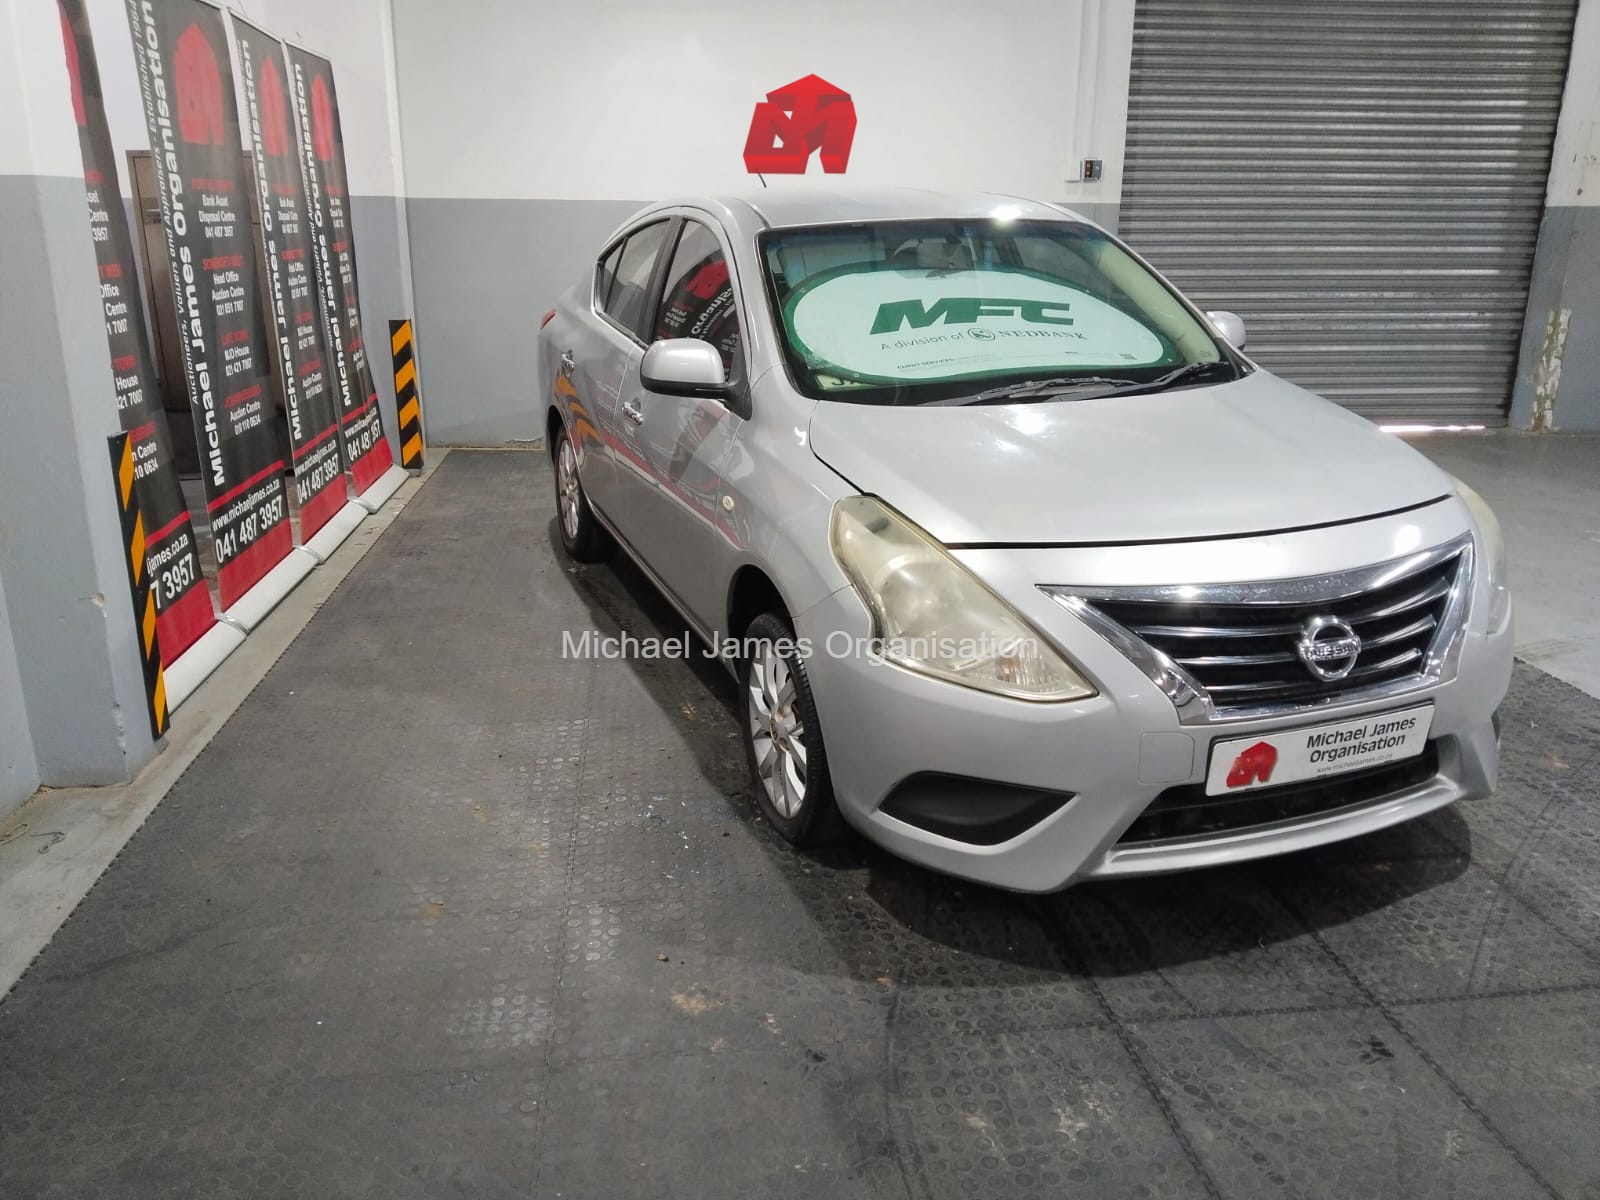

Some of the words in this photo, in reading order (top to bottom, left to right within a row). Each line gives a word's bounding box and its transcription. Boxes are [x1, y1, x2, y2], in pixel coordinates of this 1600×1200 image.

[136, 42, 157, 133] Established
[142, 0, 187, 236] Organisation
[242, 40, 272, 232] Organisation
[295, 63, 322, 228] Organisation
[154, 147, 172, 226] Appraisers
[165, 228, 177, 257] and
[171, 262, 185, 314] Valuers
[180, 246, 205, 353] James
[225, 270, 239, 283] Office
[229, 286, 245, 298] Centre
[268, 240, 286, 329] James
[319, 234, 336, 311] James
[869, 297, 1074, 335] MFC
[881, 342, 892, 351] A
[894, 334, 948, 350] division
[950, 331, 965, 341] of
[115, 375, 138, 390] House
[280, 336, 302, 440] Michael
[330, 317, 352, 407] Michael
[137, 440, 157, 458] Centre
[195, 362, 225, 487] Michael
[347, 437, 362, 463] 041
[213, 477, 281, 533] www.michaeljames.co.za
[296, 476, 312, 504] 041
[311, 465, 325, 492] 487
[323, 452, 340, 482] 3957
[215, 528, 238, 564] 041
[239, 511, 259, 545] 487
[259, 494, 283, 531] 3957
[162, 552, 195, 600] 3957
[1306, 725, 1368, 750] Michael
[1369, 717, 1417, 738] James
[1309, 733, 1406, 764] Organisation
